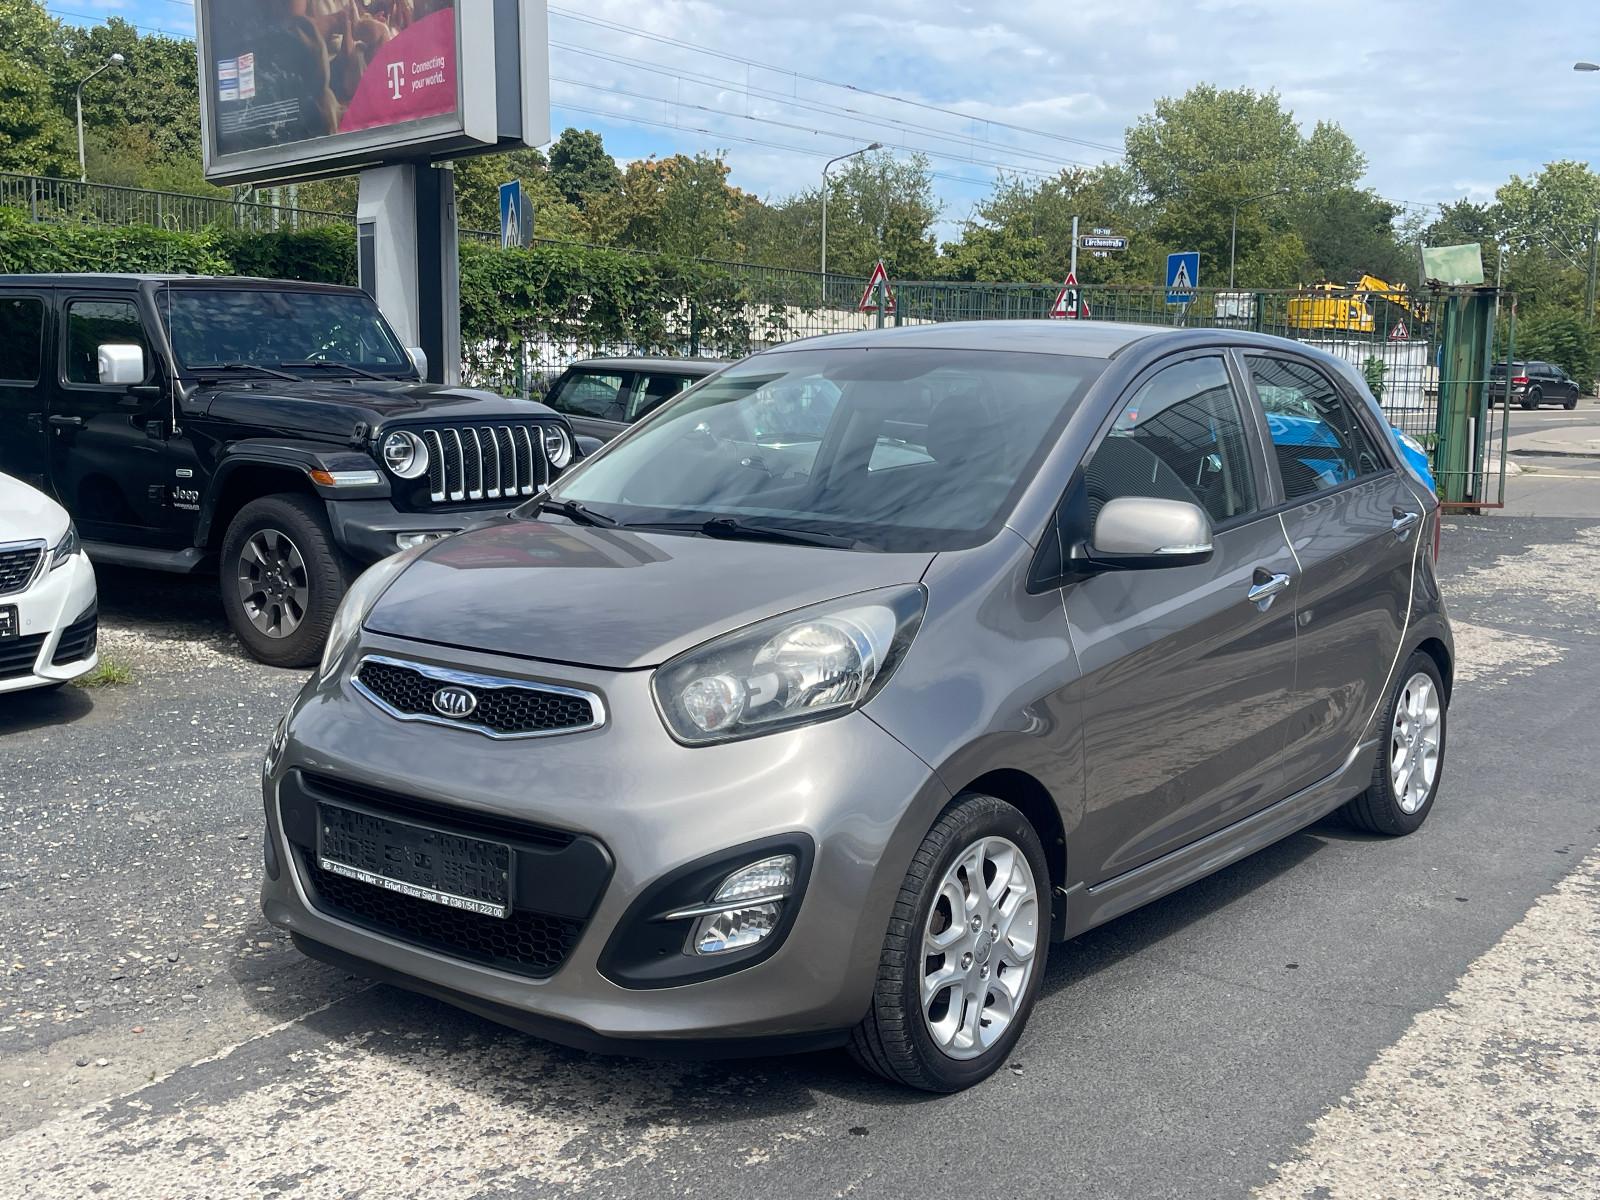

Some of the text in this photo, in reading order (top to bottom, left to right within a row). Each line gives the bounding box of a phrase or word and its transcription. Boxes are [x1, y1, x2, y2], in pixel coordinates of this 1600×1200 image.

[412, 56, 445, 74] Connecting
[387, 61, 405, 100] T
[412, 71, 446, 93] your world.
[172, 486, 199, 503] Jeep
[439, 691, 466, 713] KIA
